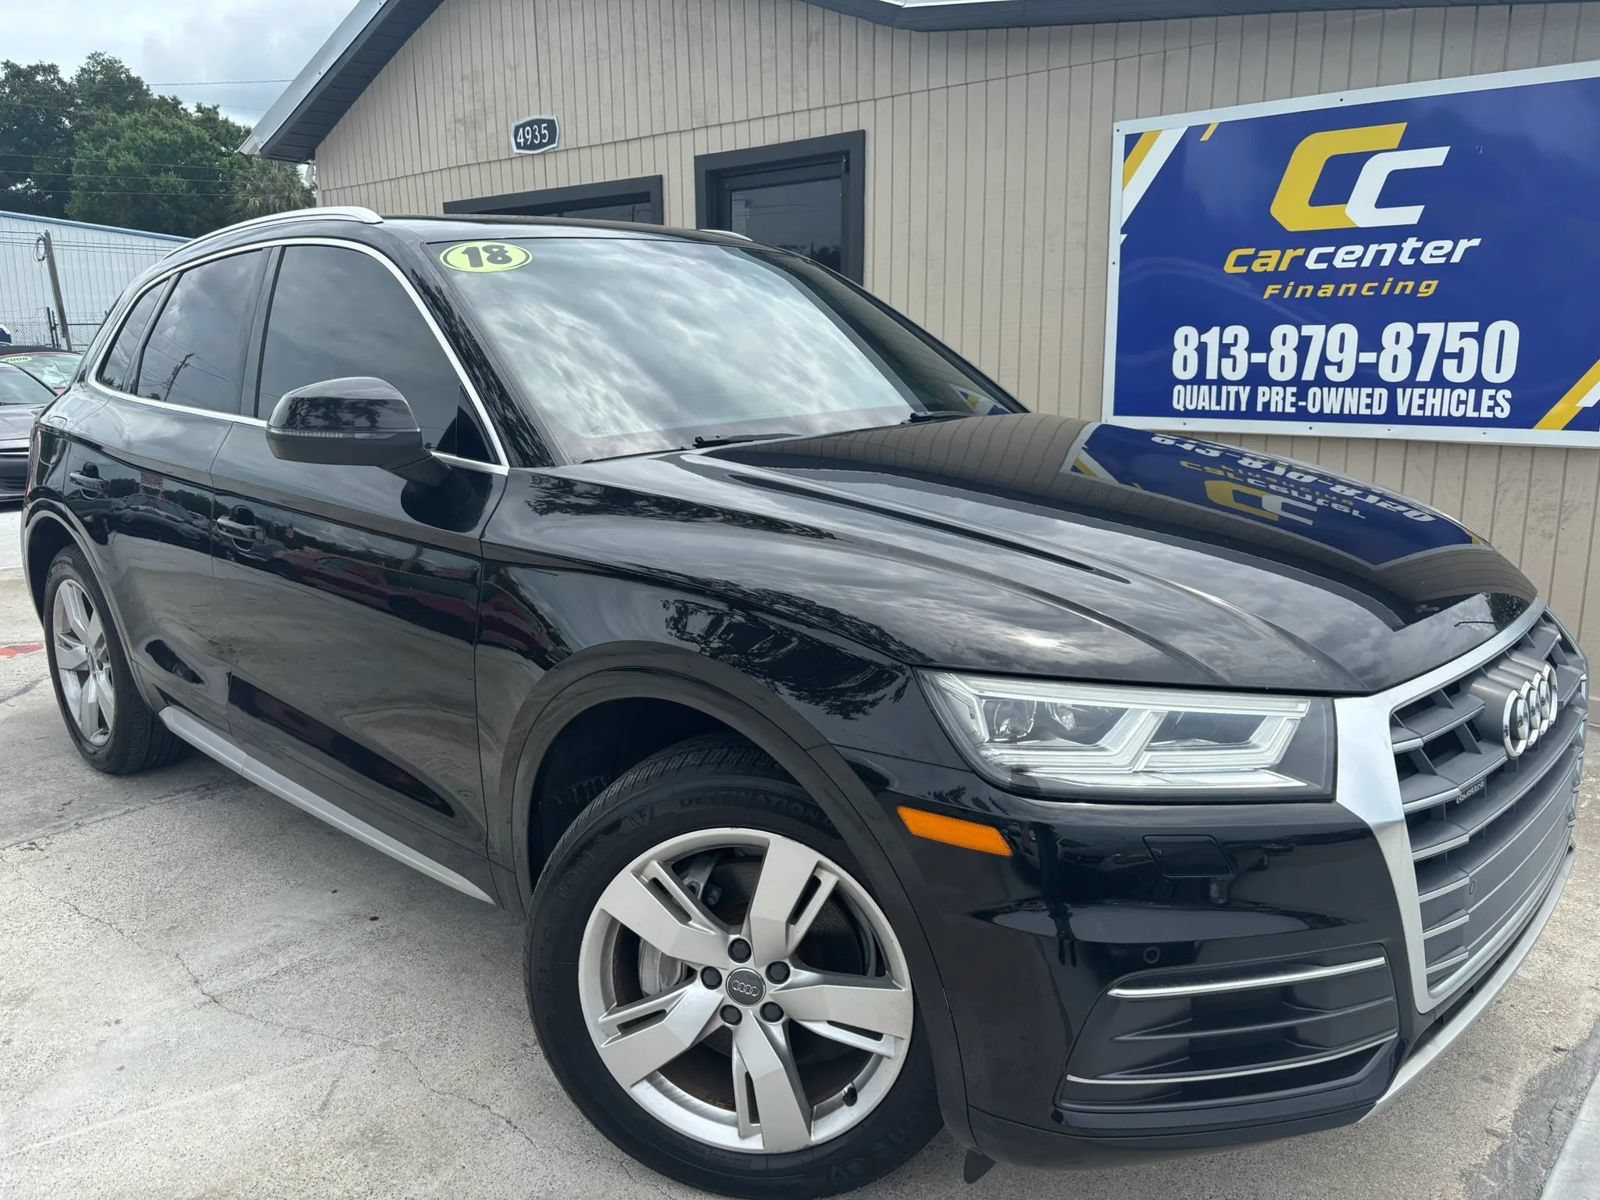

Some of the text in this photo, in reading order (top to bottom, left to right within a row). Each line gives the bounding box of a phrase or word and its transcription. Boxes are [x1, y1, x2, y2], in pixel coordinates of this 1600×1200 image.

[517, 123, 550, 147] 4935
[461, 244, 513, 268] 18
[1263, 277, 1439, 299] Financing
[1172, 320, 1520, 383] 813-879-8750
[1172, 385, 1512, 418] QUALITY PRE-OWNED VEHICLES
